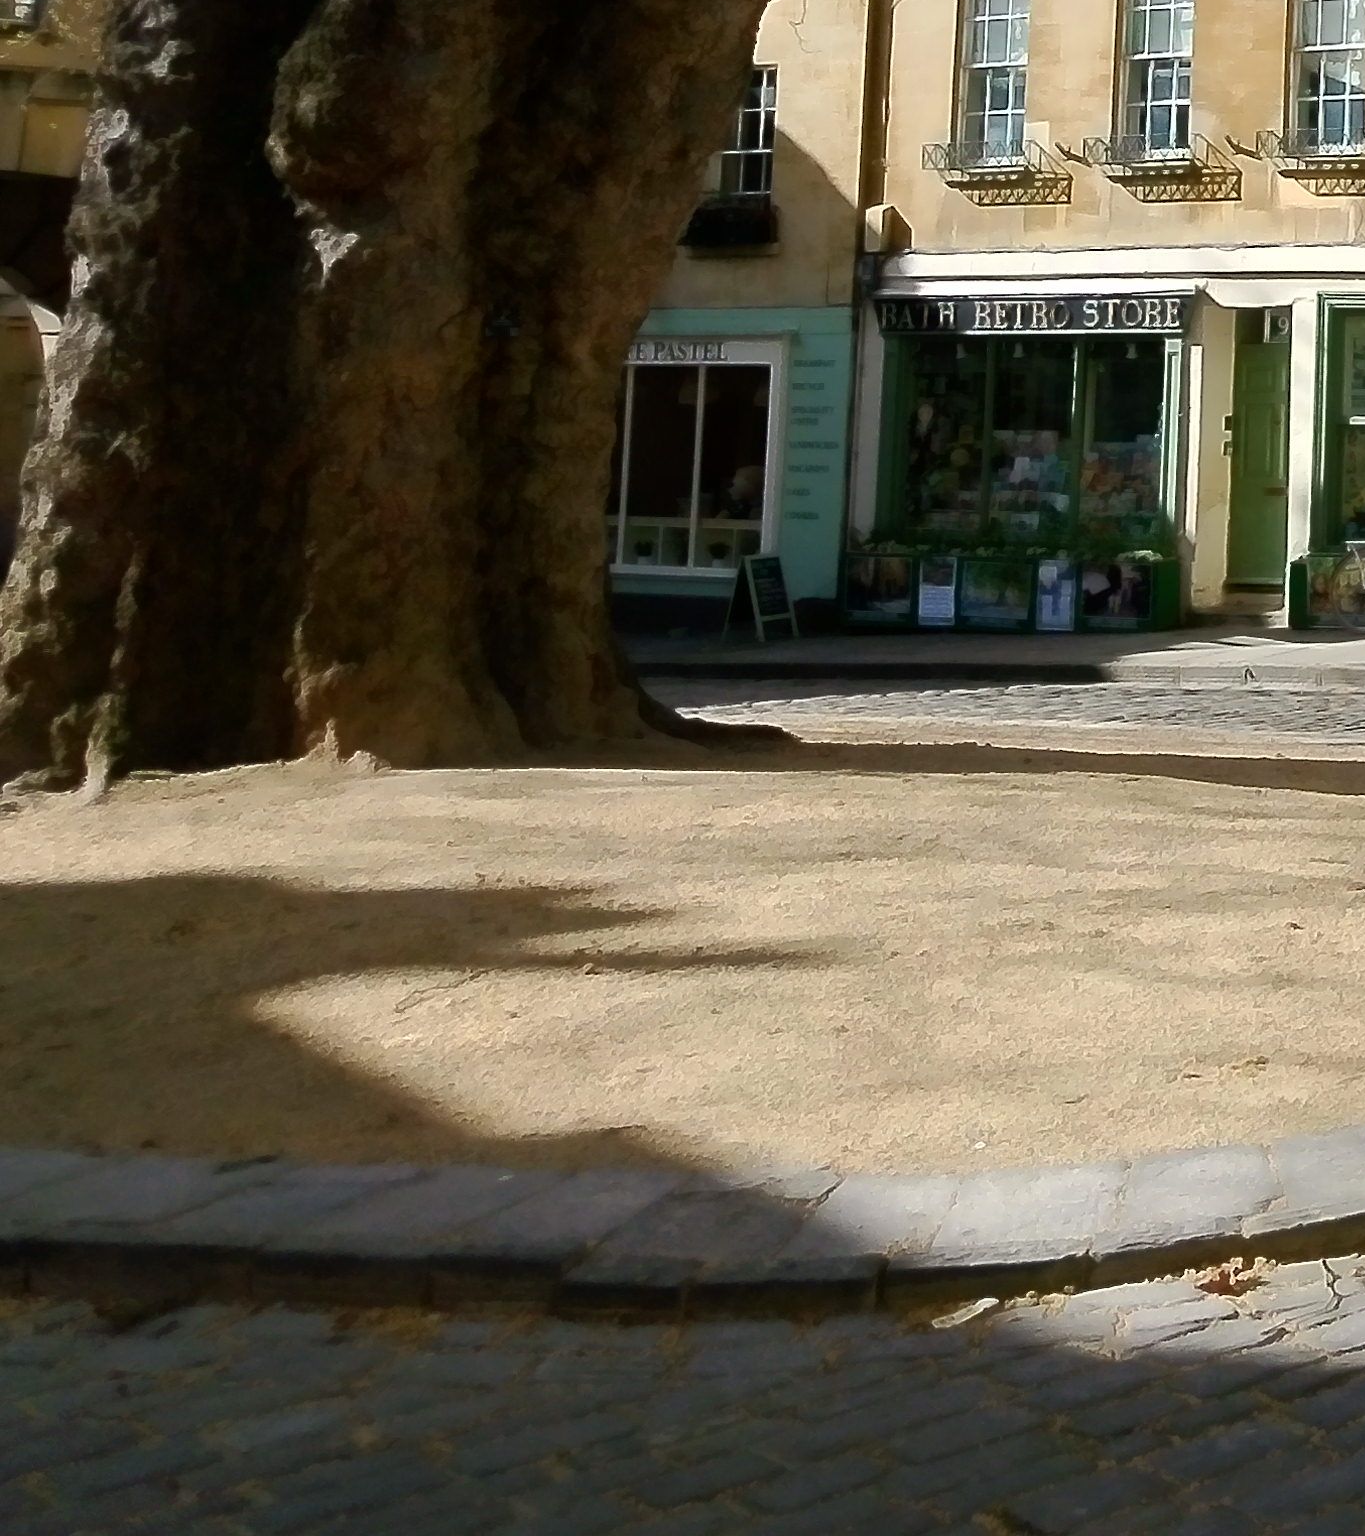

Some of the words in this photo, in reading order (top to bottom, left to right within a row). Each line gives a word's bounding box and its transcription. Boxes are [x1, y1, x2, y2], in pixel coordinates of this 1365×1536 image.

[881, 301, 956, 329] BATH
[972, 300, 1070, 329] RETRO
[1083, 299, 1181, 328] STORE
[653, 342, 728, 361] PASTEL
